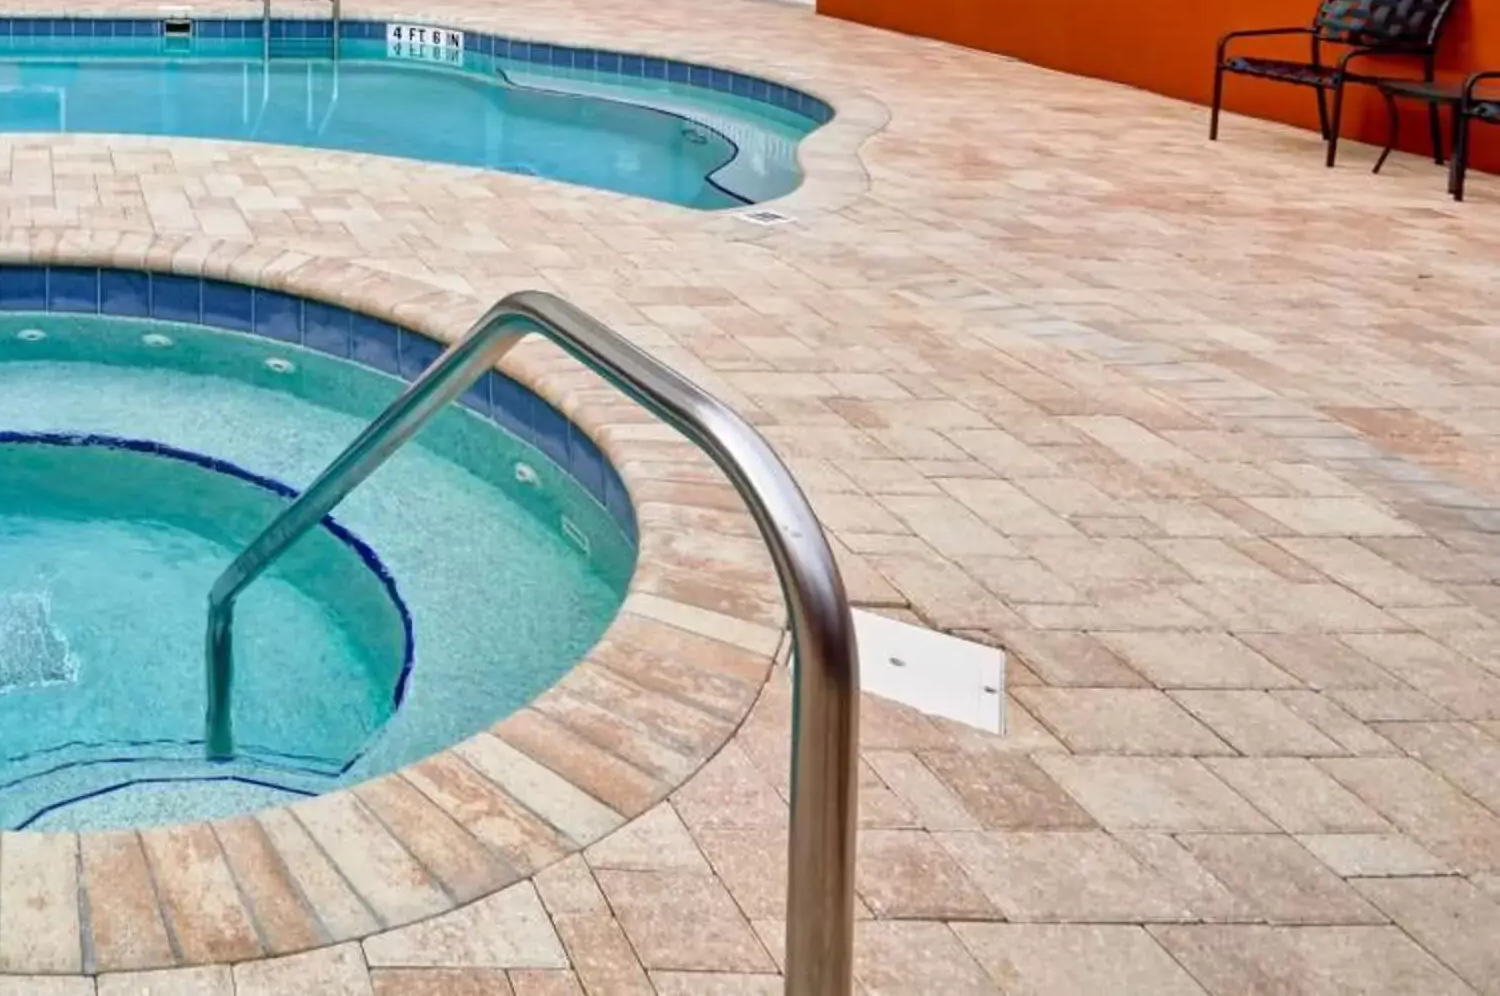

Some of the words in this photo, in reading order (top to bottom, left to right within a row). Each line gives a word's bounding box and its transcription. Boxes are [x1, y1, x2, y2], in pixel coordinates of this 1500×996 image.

[393, 25, 403, 41] 4
[408, 26, 427, 43] FT
[433, 31, 442, 45] 6
[445, 31, 460, 48] IN
